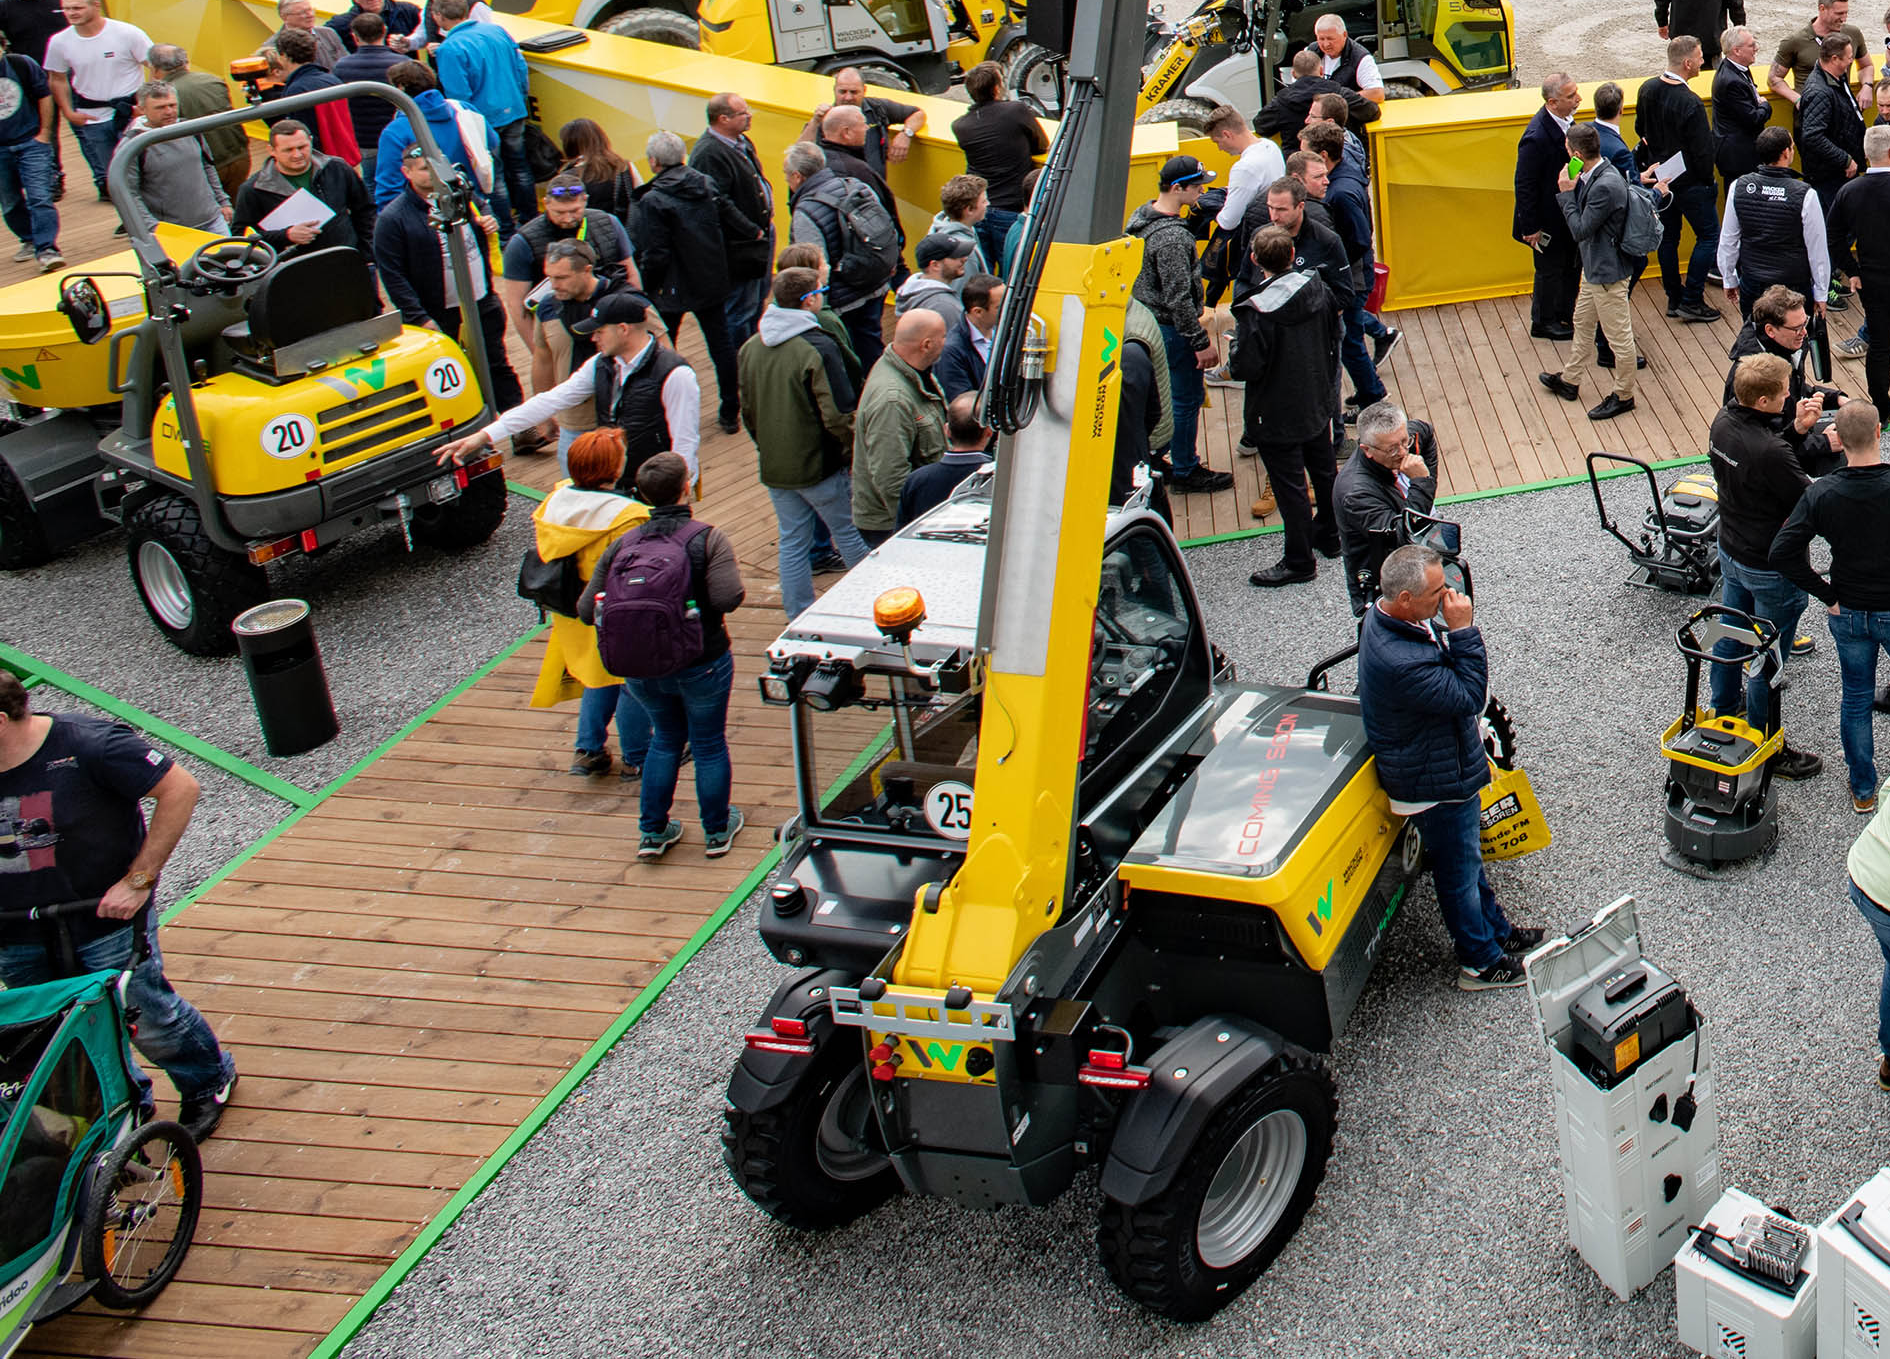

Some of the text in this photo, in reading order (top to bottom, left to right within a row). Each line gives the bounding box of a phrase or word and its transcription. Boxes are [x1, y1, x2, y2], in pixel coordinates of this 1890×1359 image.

[837, 28, 869, 37] WACKER
[838, 33, 872, 43] NEUSON
[1145, 56, 1185, 102] KRAMER
[432, 362, 461, 394] 20
[272, 420, 303, 452] 20
[1237, 713, 1299, 856] COMING SOON
[938, 792, 972, 830] 25
[1480, 795, 1516, 822] SER
[1512, 818, 1530, 831] FM
[1500, 832, 1528, 851] 708
